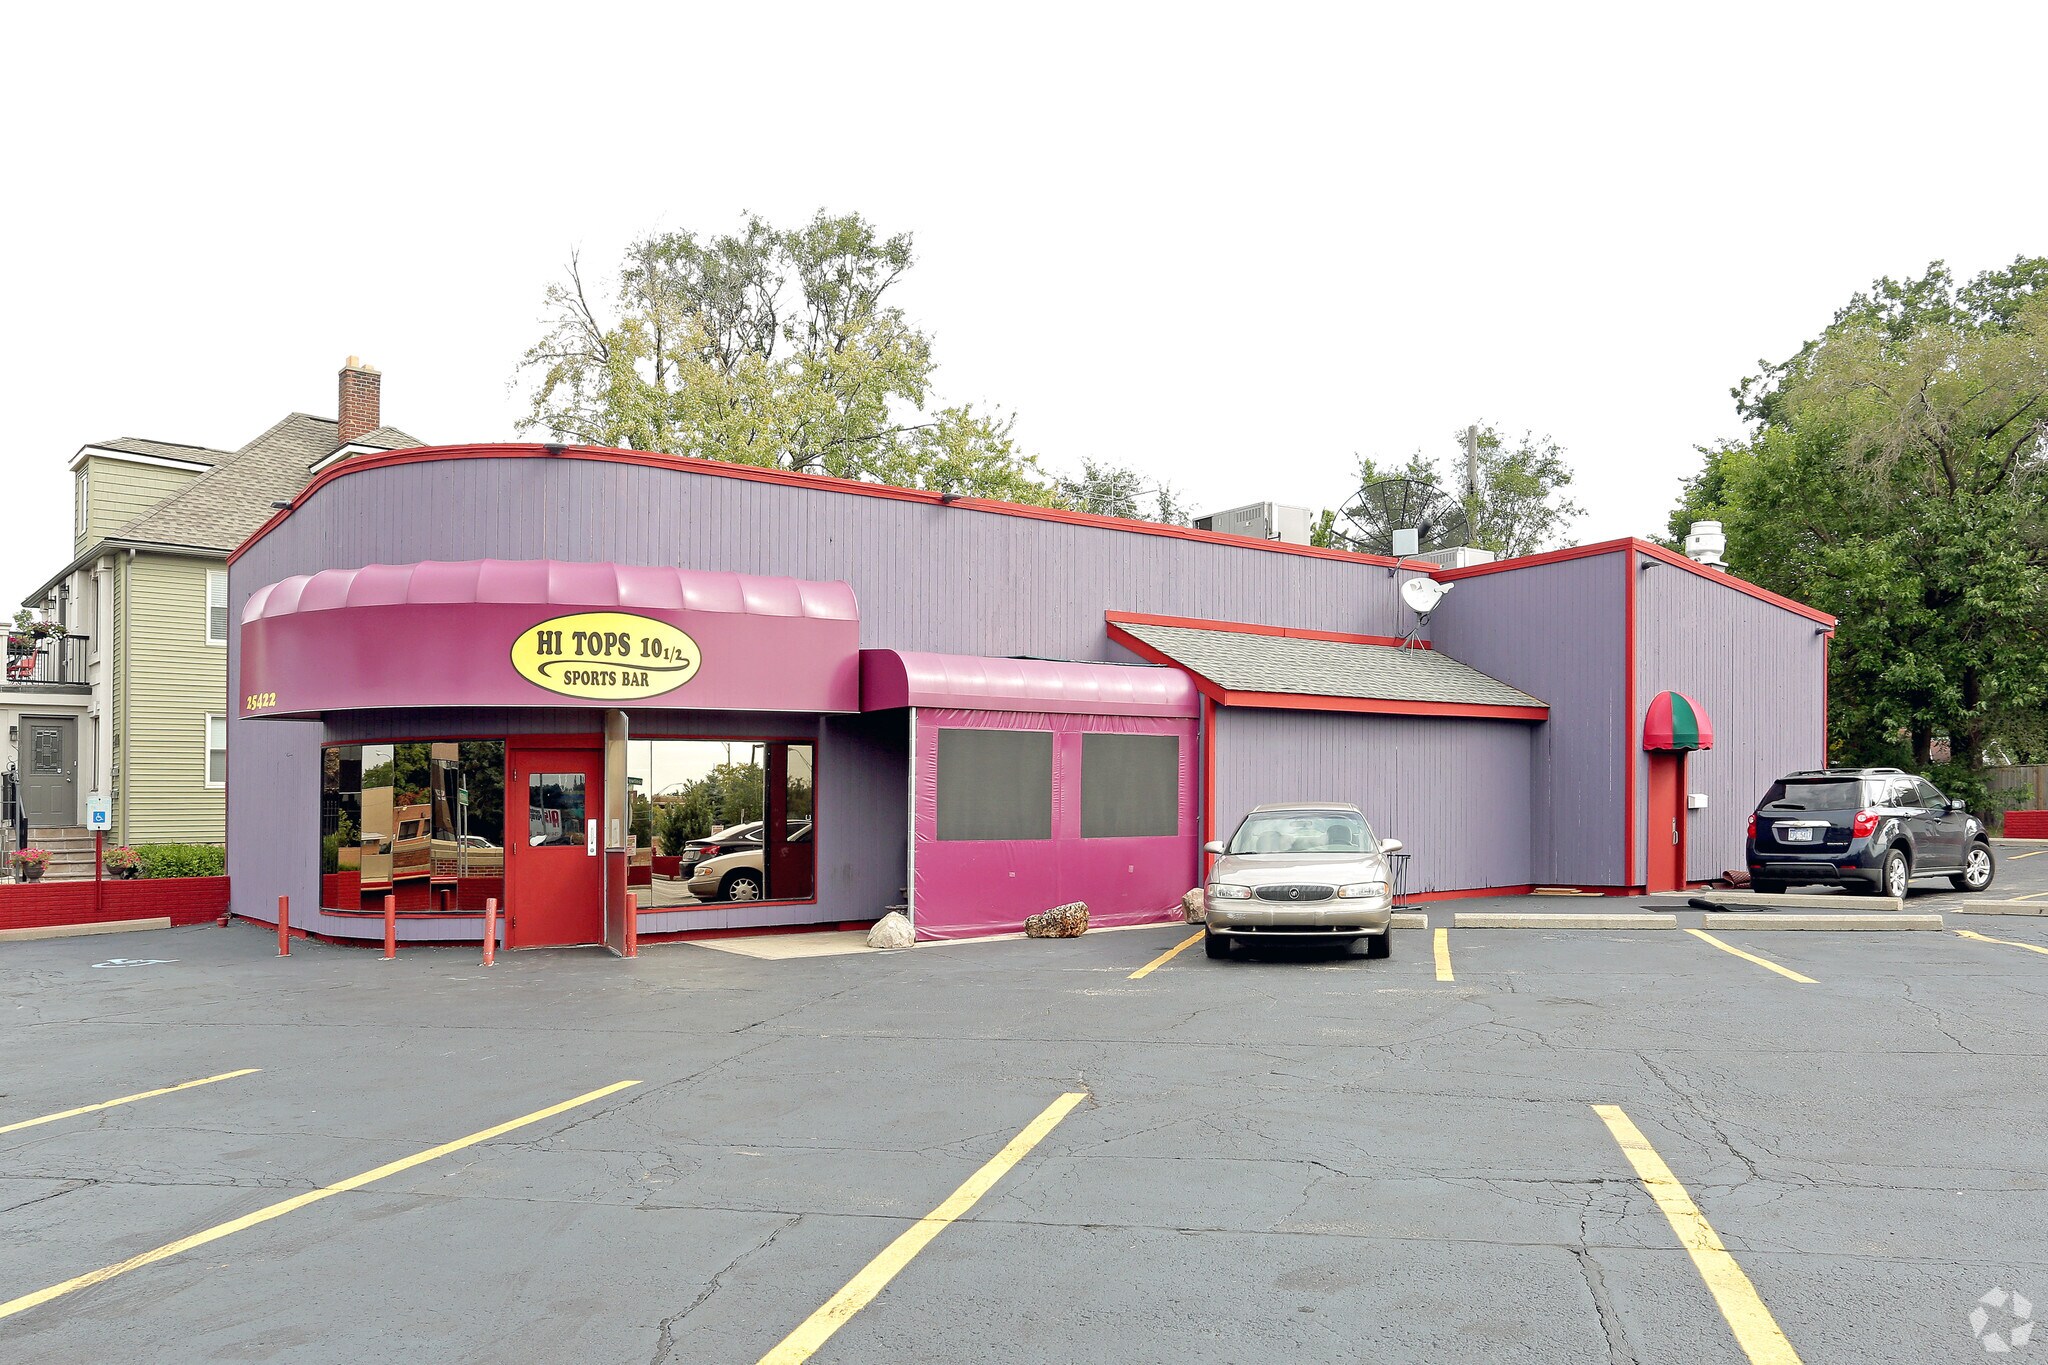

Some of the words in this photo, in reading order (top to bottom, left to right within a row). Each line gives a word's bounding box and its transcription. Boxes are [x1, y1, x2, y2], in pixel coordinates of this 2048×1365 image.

[536, 630, 563, 655] HI
[572, 631, 631, 656] TOPS
[563, 670, 617, 686] SPORTS
[621, 671, 650, 687] BAR
[246, 692, 276, 710] 25422
